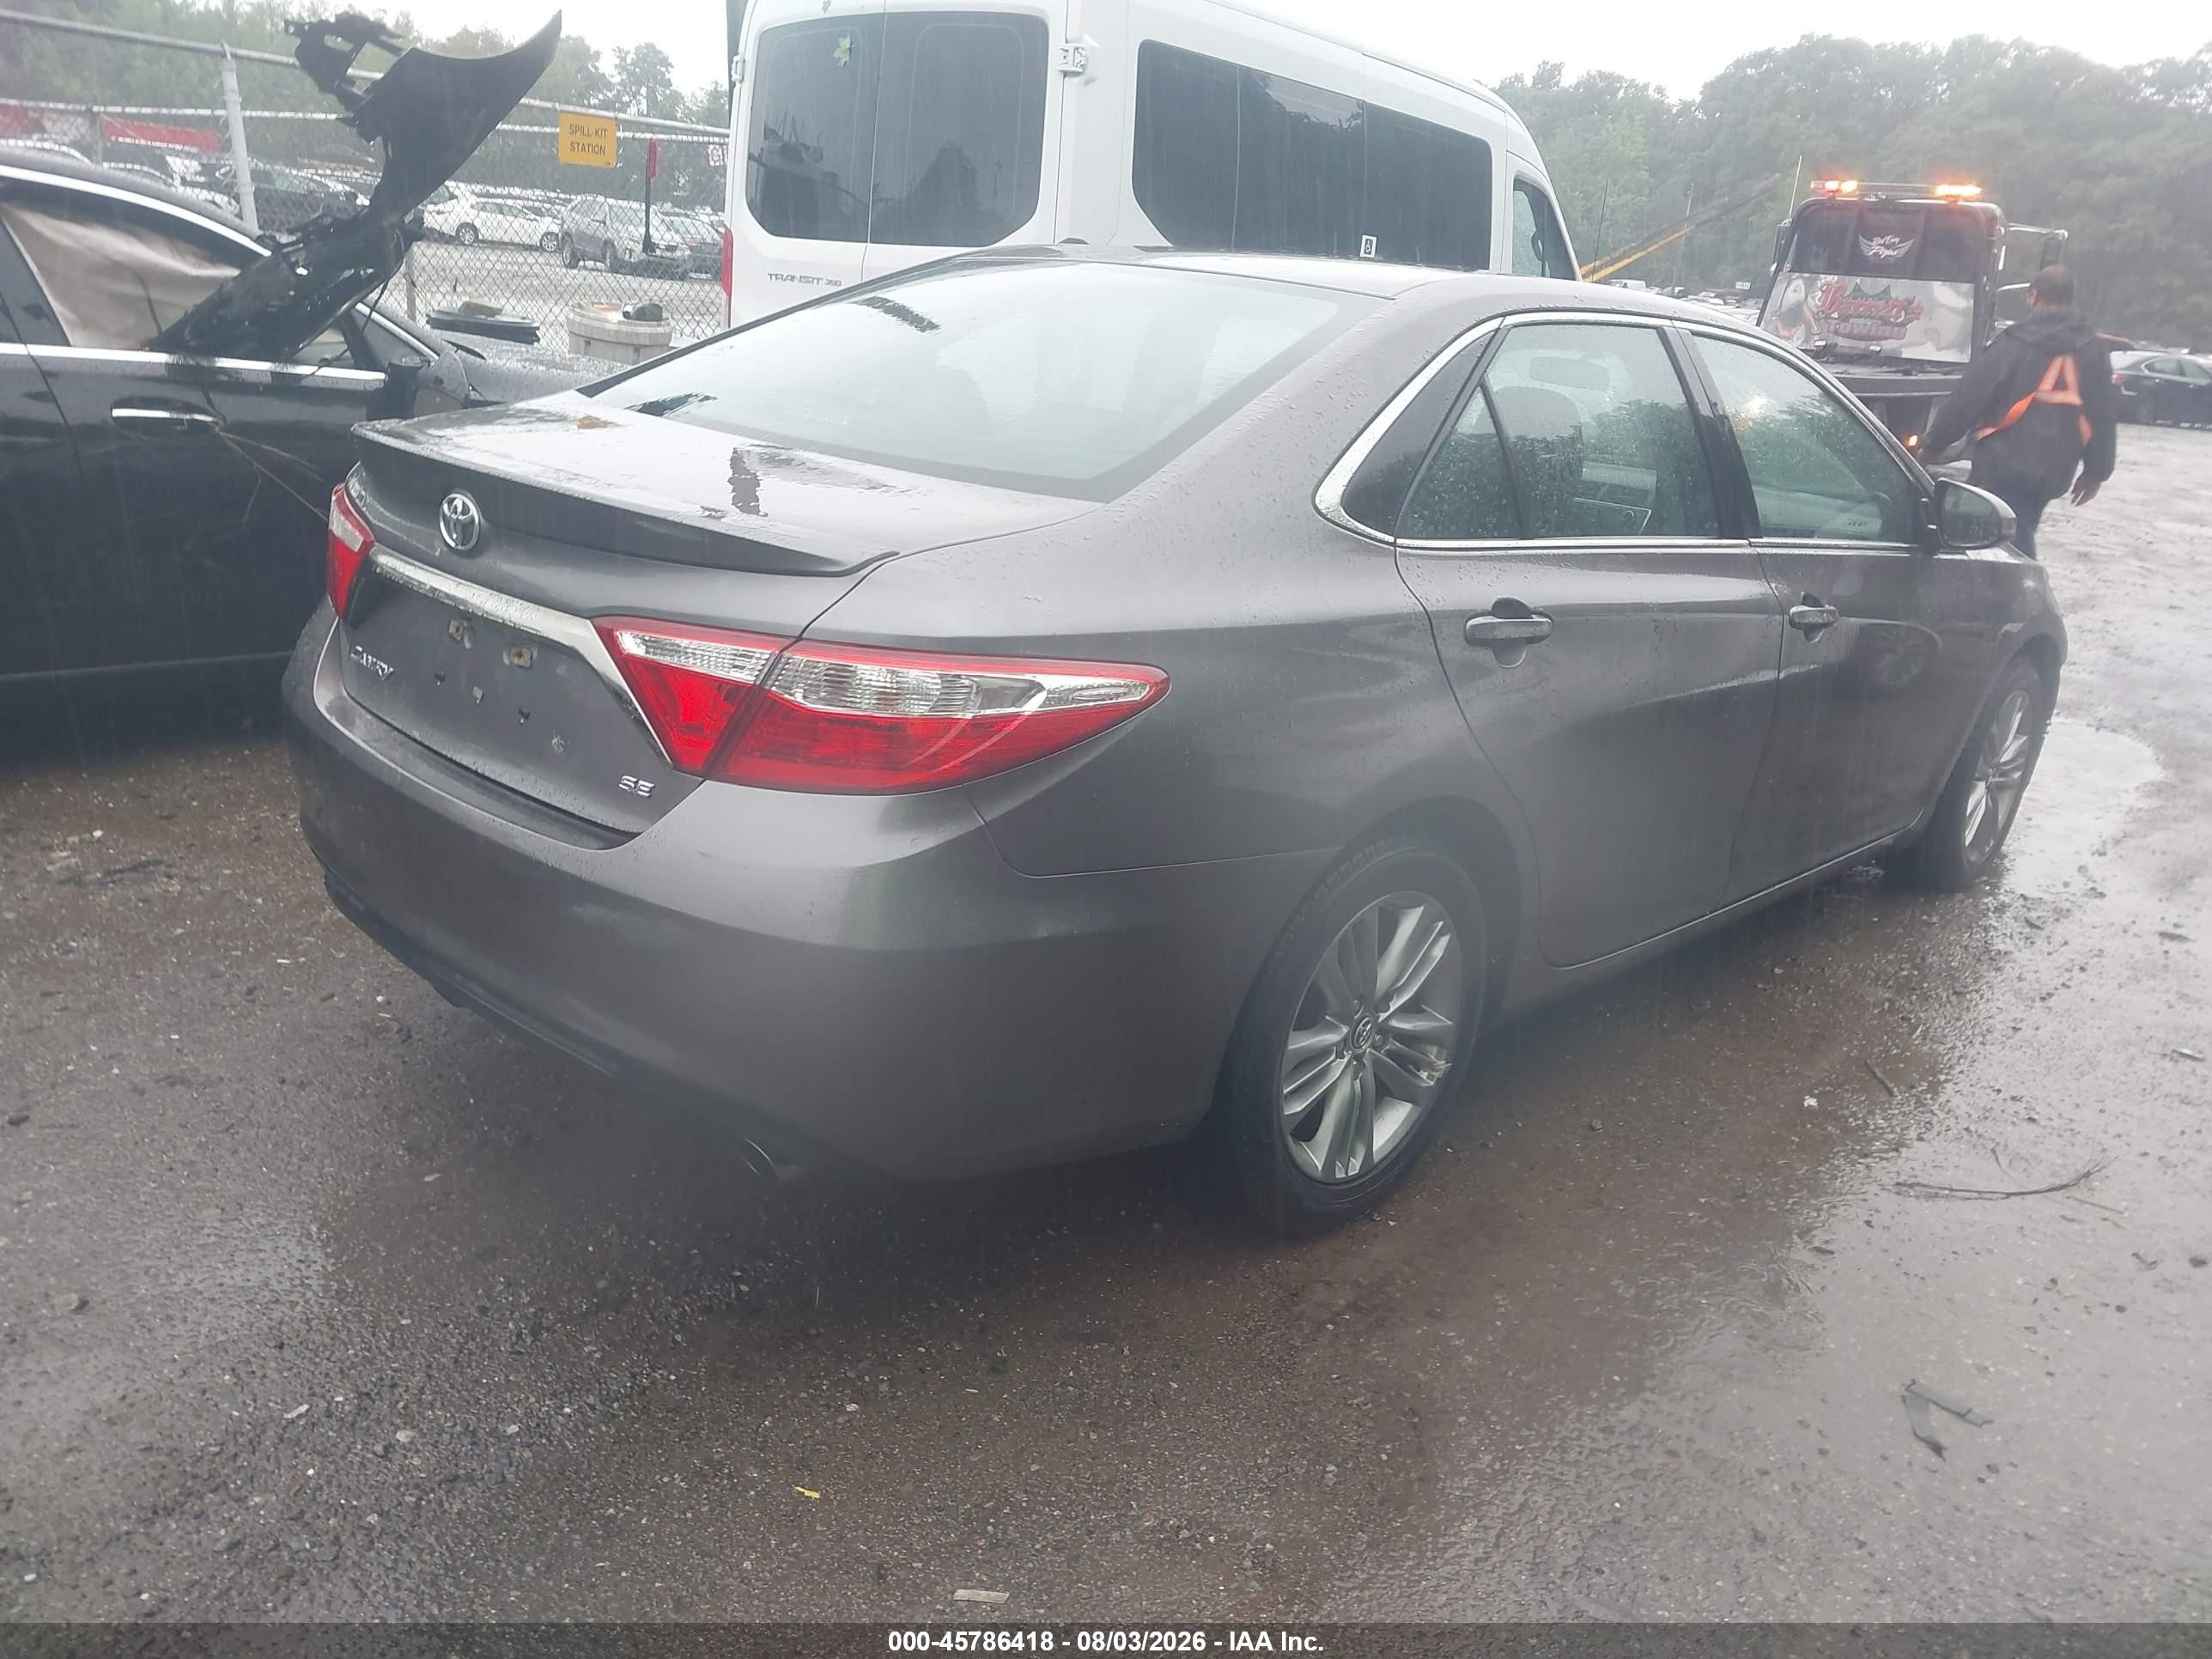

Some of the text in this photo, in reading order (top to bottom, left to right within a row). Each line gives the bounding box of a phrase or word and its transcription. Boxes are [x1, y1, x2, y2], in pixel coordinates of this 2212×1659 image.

[569, 124, 608, 138] SPILL-KIT
[569, 141, 605, 155] STATION
[767, 272, 823, 285] TRANSIT
[618, 775, 655, 798] SE
